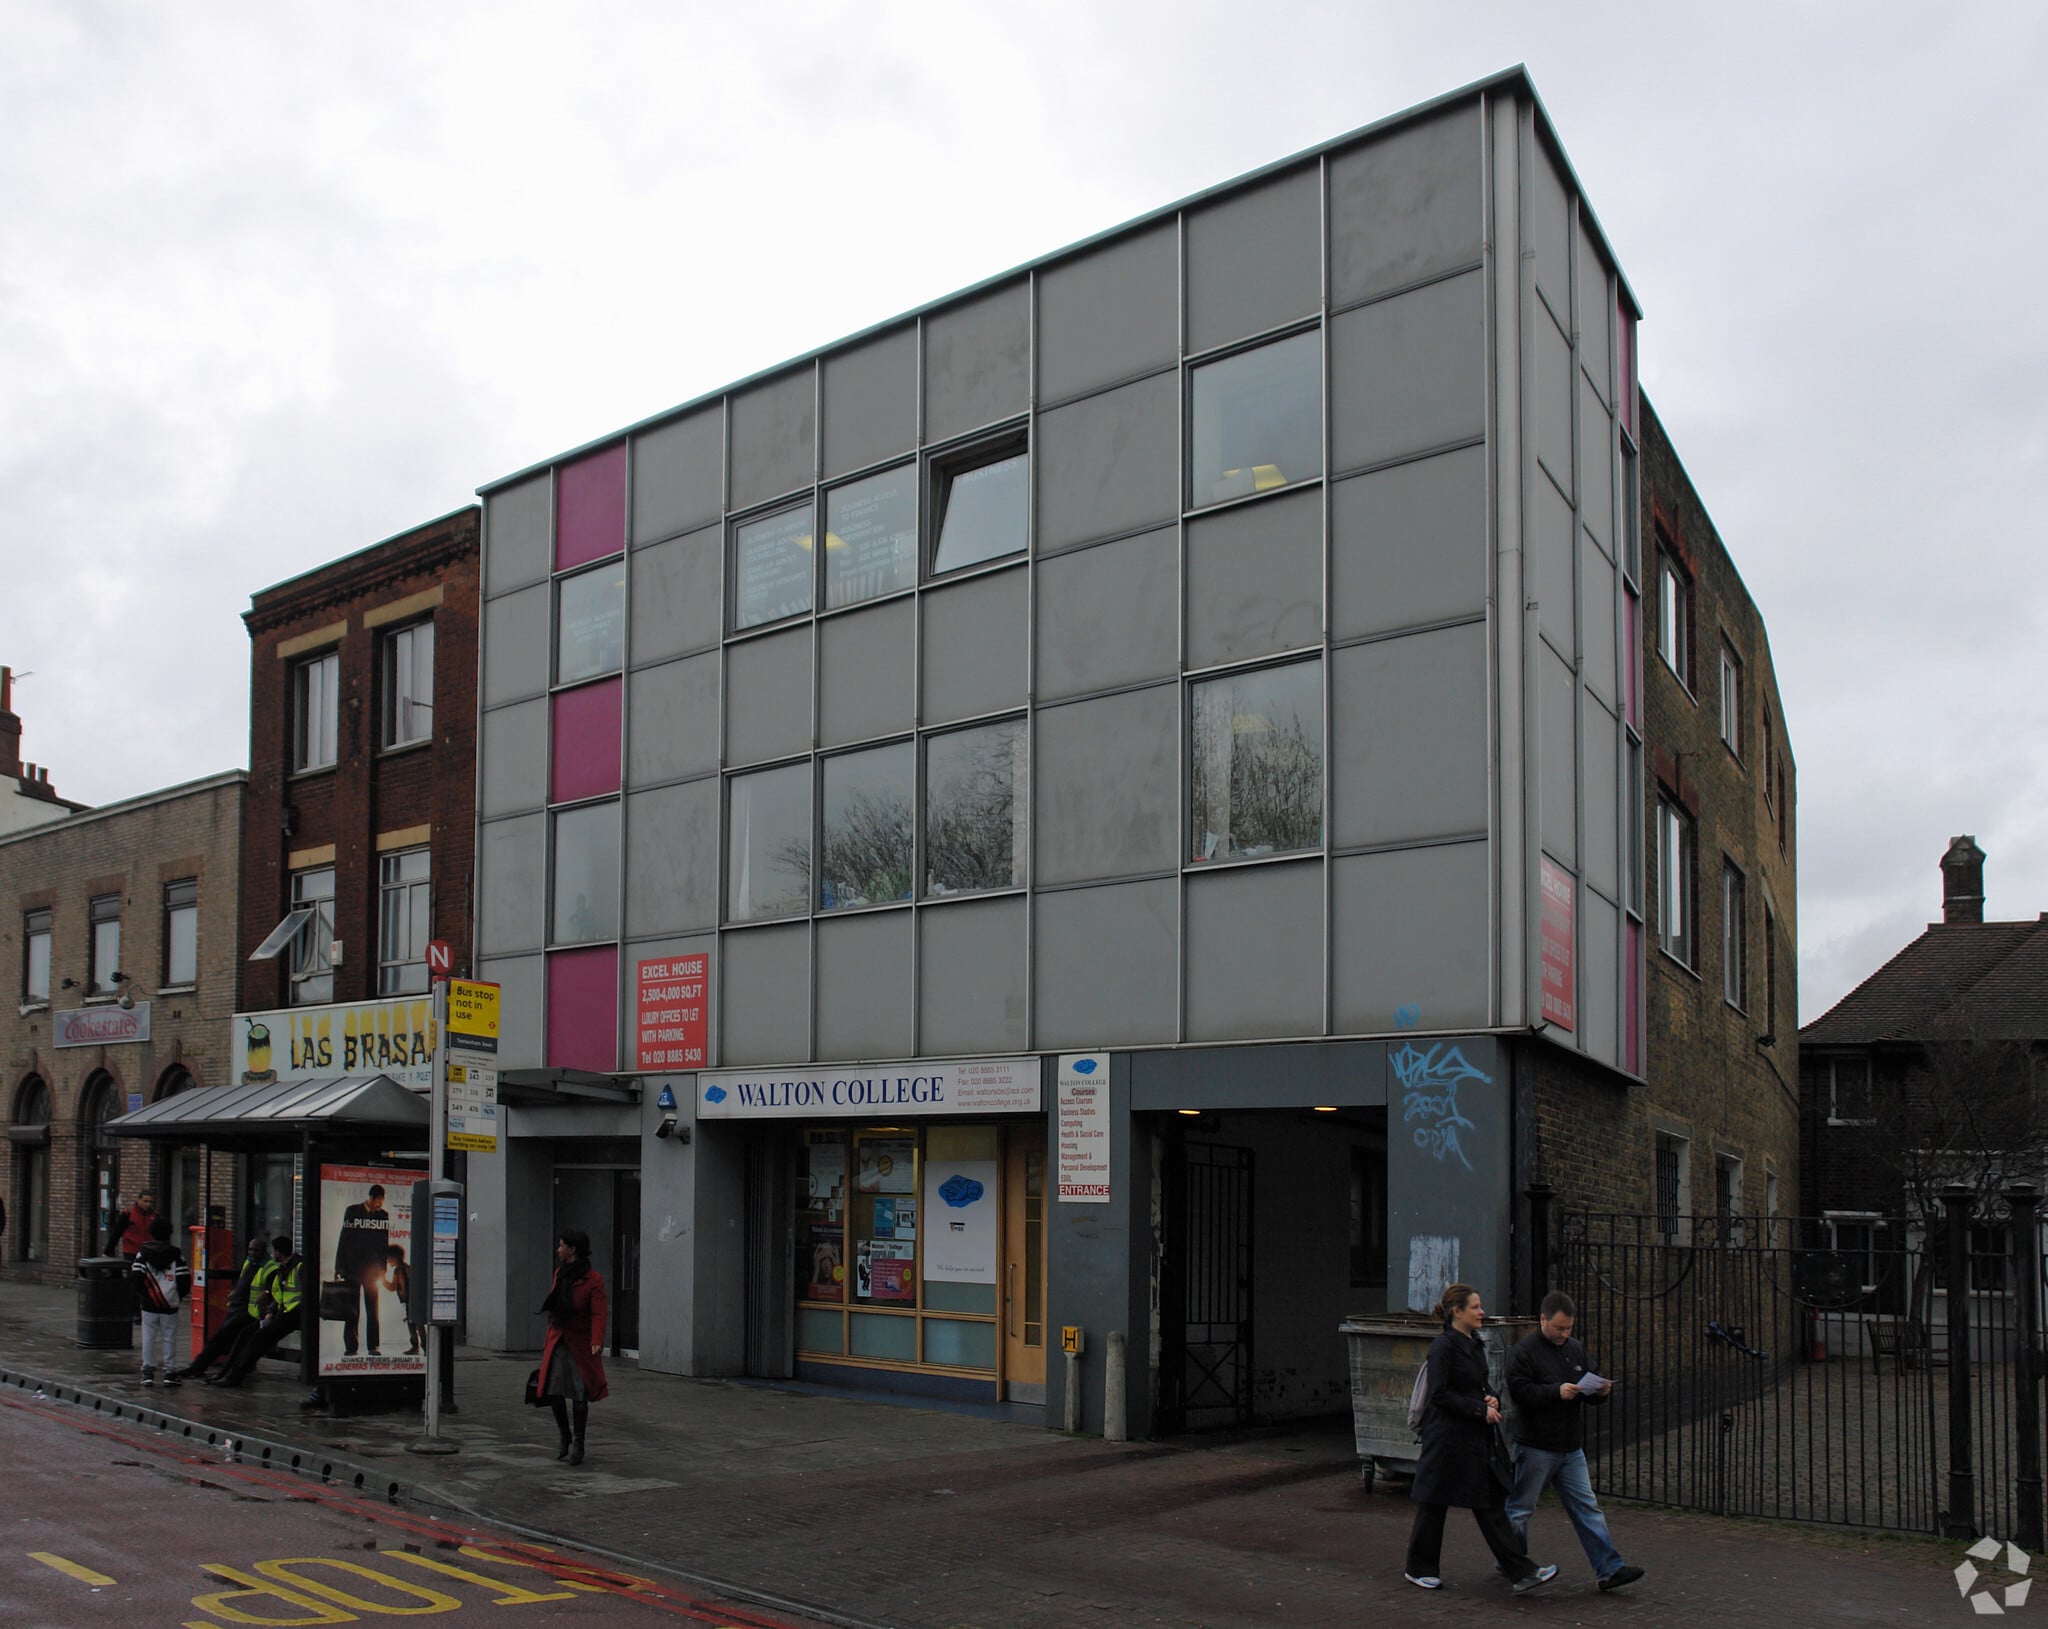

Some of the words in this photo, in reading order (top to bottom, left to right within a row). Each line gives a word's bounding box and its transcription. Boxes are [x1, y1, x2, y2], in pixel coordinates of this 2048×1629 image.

[430, 945, 449, 968] N
[642, 963, 669, 979] EXCEL
[672, 961, 703, 976] HOUSE
[456, 986, 473, 997] Bus
[474, 990, 495, 1001] stop
[642, 986, 680, 1004] 2,500-4,000
[681, 984, 702, 999] SQ.FT
[456, 1000, 472, 1009] not
[474, 1001, 483, 1010] in
[456, 1012, 472, 1020] use
[642, 1011, 659, 1025] LUXURY
[660, 1009, 681, 1023] OFFICES
[681, 1008, 689, 1022] TO
[689, 1008, 699, 1021] LET
[642, 1030, 656, 1043] WITH
[290, 1036, 333, 1071] LAS
[344, 1031, 432, 1072] BRASA
[642, 1051, 651, 1064] Tel
[653, 1050, 665, 1063] 020
[667, 1049, 683, 1063] 8885
[685, 1048, 702, 1062] 5430
[969, 1066, 979, 1074] 020
[996, 1065, 1010, 1073] 3111
[998, 1076, 1012, 1084] 3222
[737, 1081, 825, 1107] WALTON
[832, 1076, 945, 1105] COLLEGE
[1071, 1088, 1096, 1096] Courses
[1060, 1108, 1079, 1116] Business
[1060, 1120, 1083, 1128] Computing
[1094, 1130, 1104, 1138] Care
[1060, 1152, 1088, 1161] Management
[1080, 1164, 1108, 1172] Development
[1060, 1185, 1109, 1195] ENTRANCE
[343, 1220, 354, 1229] the
[354, 1219, 389, 1230] PURSUIT
[1064, 1330, 1076, 1349] H
[324, 1363, 334, 1371] AT
[335, 1362, 368, 1371] CINEMAS
[369, 1362, 390, 1370] FROM
[392, 1362, 425, 1371] JANUARY
